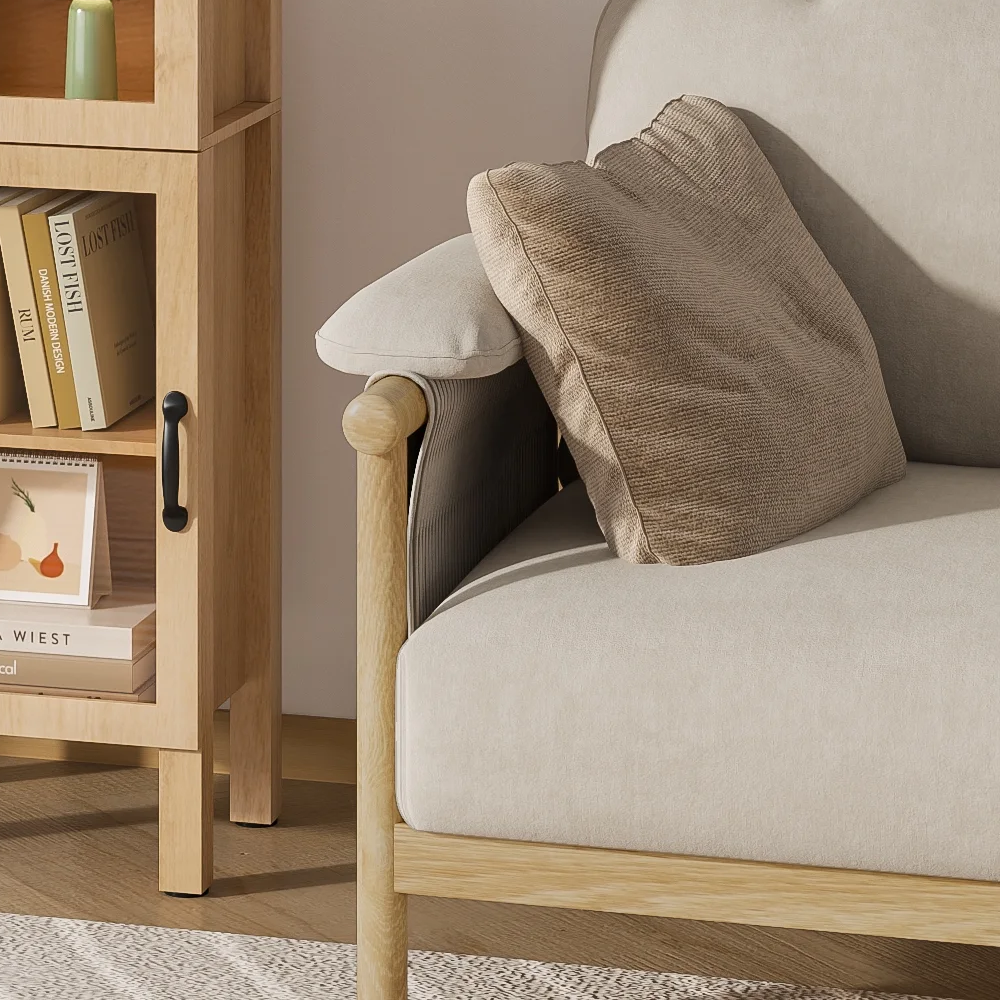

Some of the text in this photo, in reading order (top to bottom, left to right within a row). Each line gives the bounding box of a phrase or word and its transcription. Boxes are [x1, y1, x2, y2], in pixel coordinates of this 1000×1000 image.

[81, 210, 135, 258] LOST FISH
[54, 220, 83, 313] LOST FISH
[18, 308, 36, 342] RUM
[38, 268, 65, 374] DANISH MODERN DESIGN
[13, 630, 71, 646] WIEST
